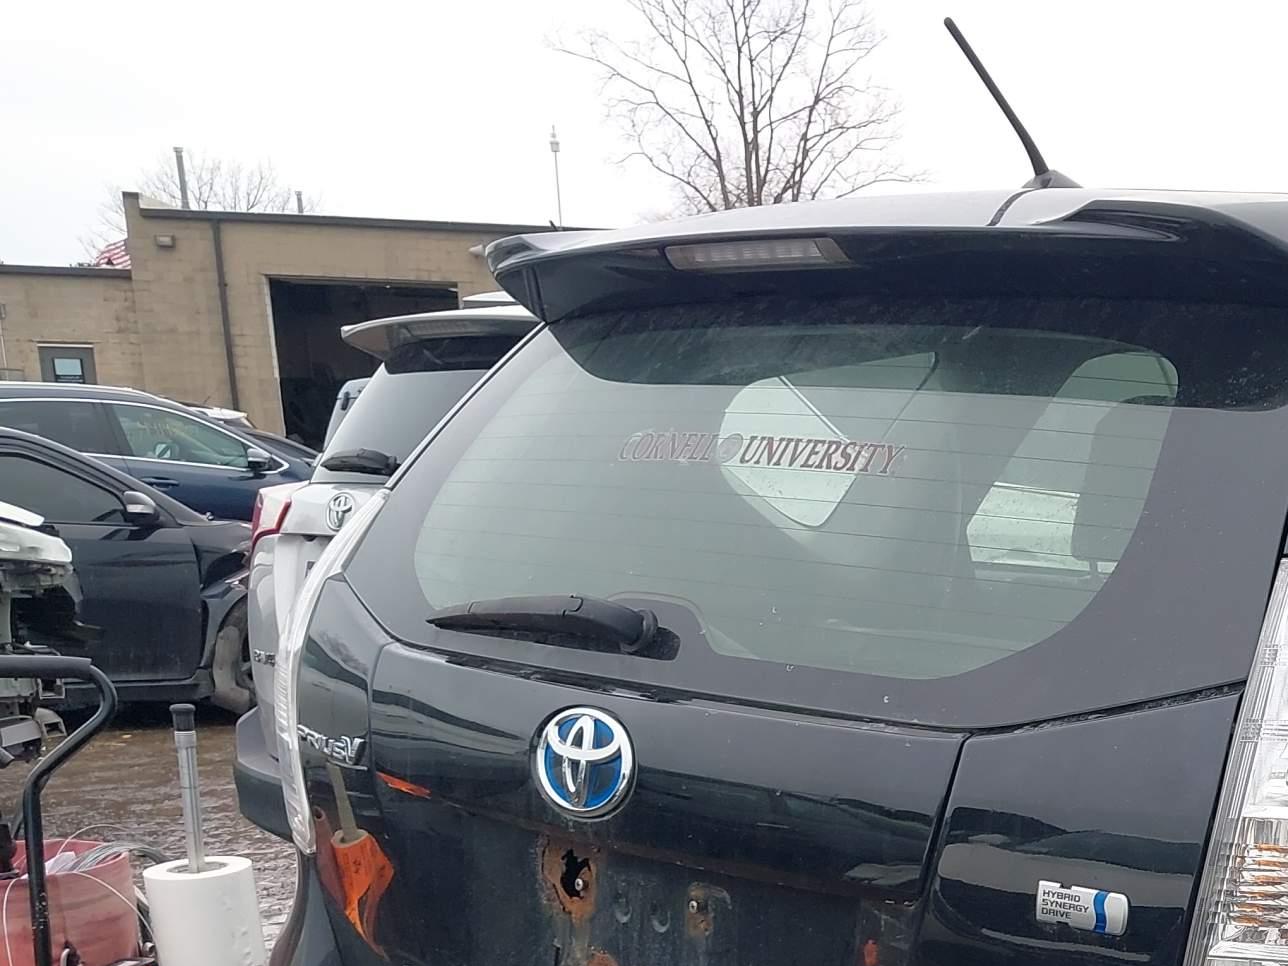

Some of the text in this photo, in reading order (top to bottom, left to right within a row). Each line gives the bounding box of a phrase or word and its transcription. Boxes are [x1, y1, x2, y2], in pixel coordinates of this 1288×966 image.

[618, 429, 905, 475] CORNELL UNIVERSITY
[1042, 889, 1081, 903] HYBRID
[1041, 898, 1090, 914] SYNERGY
[1041, 907, 1073, 920] DRIVE
